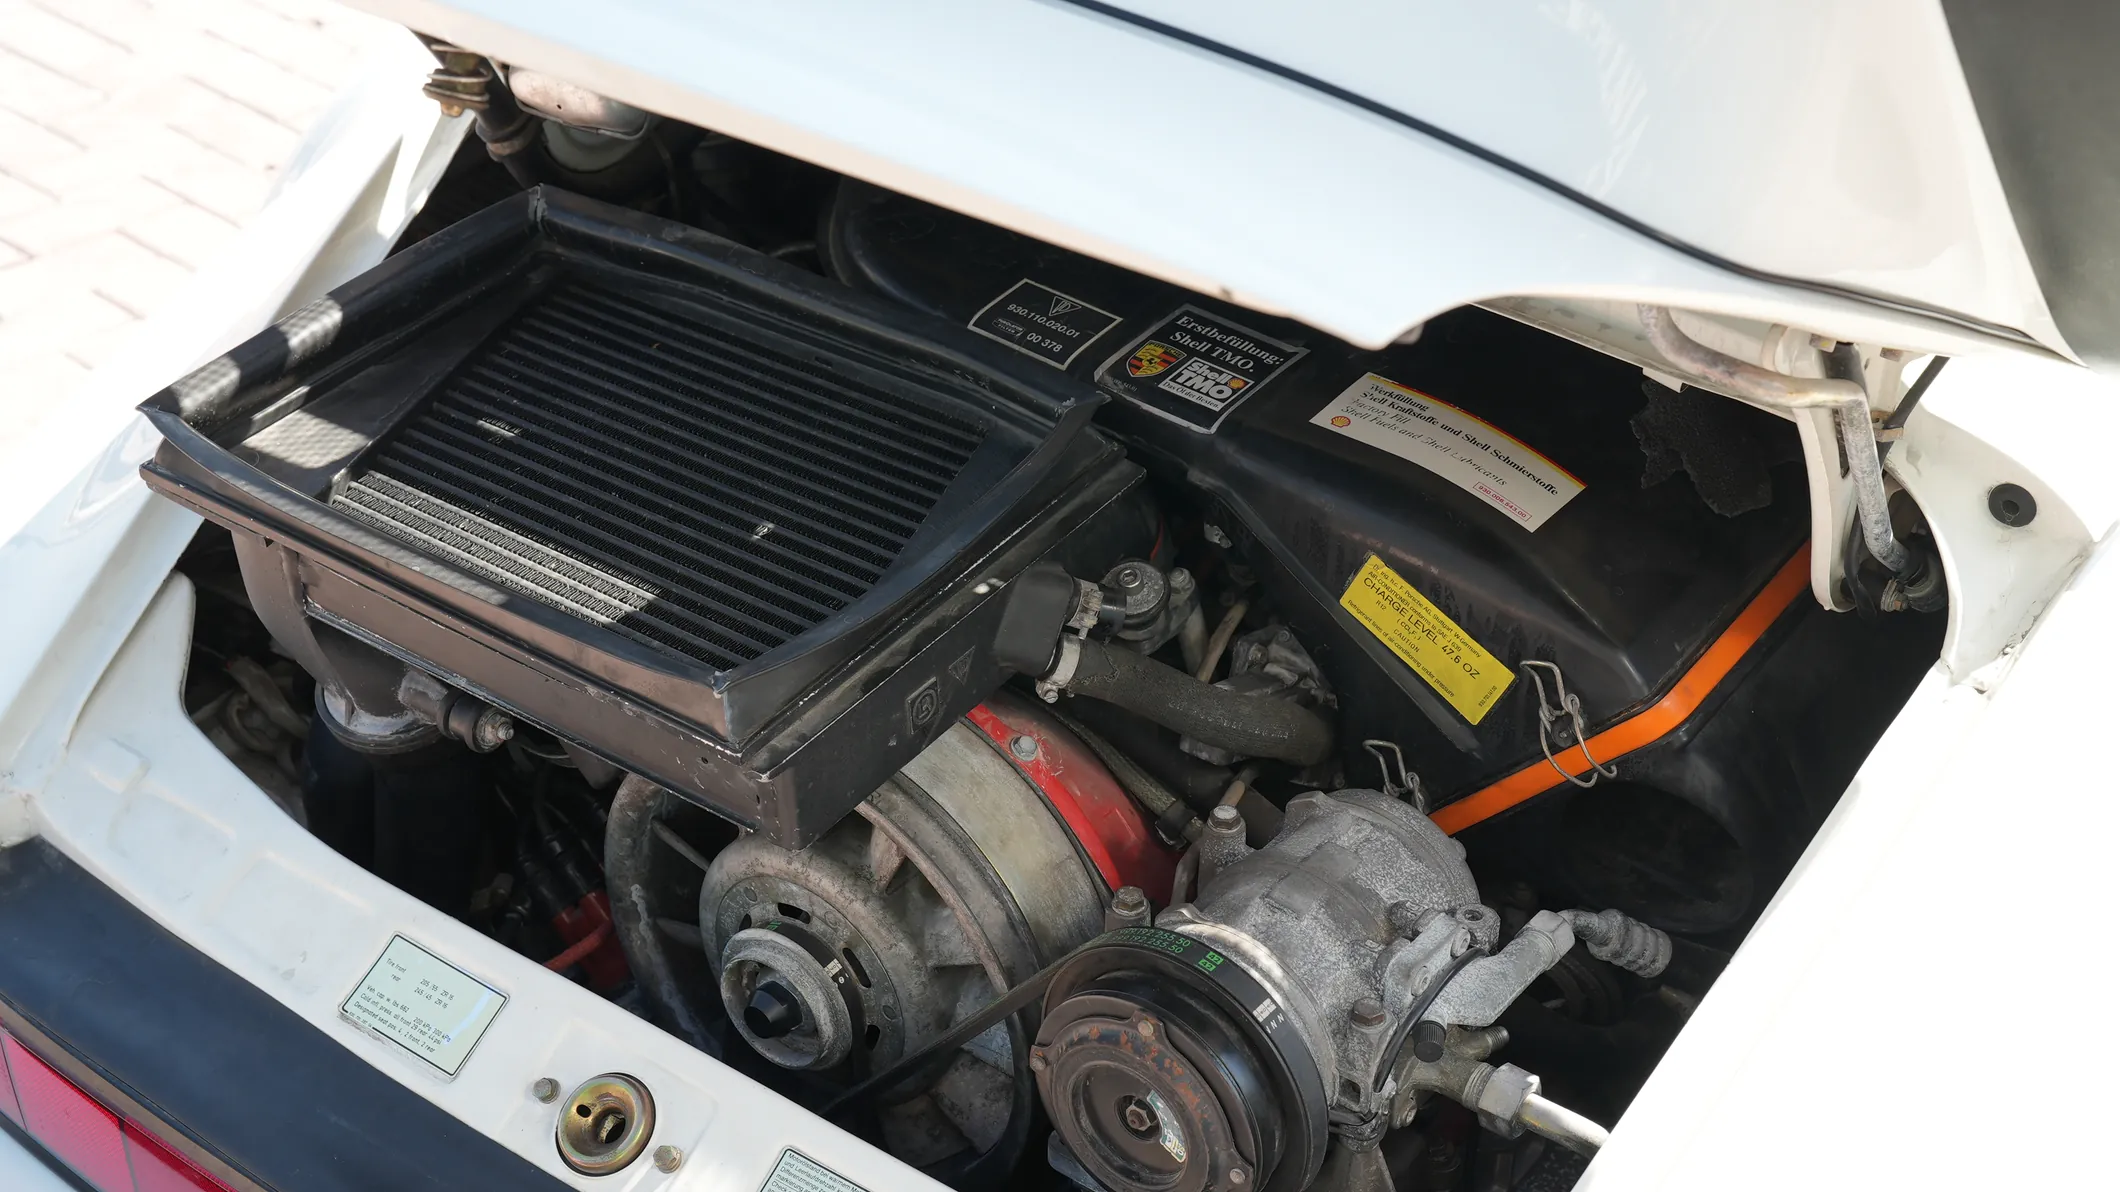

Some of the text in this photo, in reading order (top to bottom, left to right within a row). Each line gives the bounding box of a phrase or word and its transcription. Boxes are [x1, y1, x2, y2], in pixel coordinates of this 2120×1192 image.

[1007, 304, 1080, 338] 930.110.020.01
[1026, 332, 1062, 352] 00 378
[1170, 331, 1212, 352] Shell
[1210, 346, 1254, 373] TMO.
[1175, 316, 1284, 366] Erstbefüllung:
[1176, 370, 1233, 399] TMO
[1187, 360, 1233, 385] Shell
[1341, 405, 1372, 420] Shell
[1370, 416, 1399, 431] Fuels
[1399, 429, 1423, 440] and
[1390, 413, 1411, 424] Fill
[1360, 391, 1558, 496] Shell Kraftstoffe und Shell Schmierstoffe
[1368, 571, 1409, 606] AIR-CONDITIONER
[1410, 606, 1432, 625] conforms
[1405, 590, 1423, 608] Porsche
[1433, 614, 1453, 632] Stuttgart
[1364, 577, 1480, 680] CHARGE LEVEL 47.6 OZ
[1393, 629, 1420, 652] CAUTION
[1348, 600, 1372, 623] Refrigerant
[1372, 621, 1382, 632] lines
[1388, 636, 1422, 668] air-conditioning
[1422, 666, 1435, 678] under
[1434, 677, 1455, 697] pressure
[395, 964, 406, 973] front
[1208, 952, 1220, 963] 42
[414, 987, 424, 995] 245
[420, 979, 430, 987] 205
[354, 1001, 378, 1019] Designated
[784, 1161, 795, 1169] und
